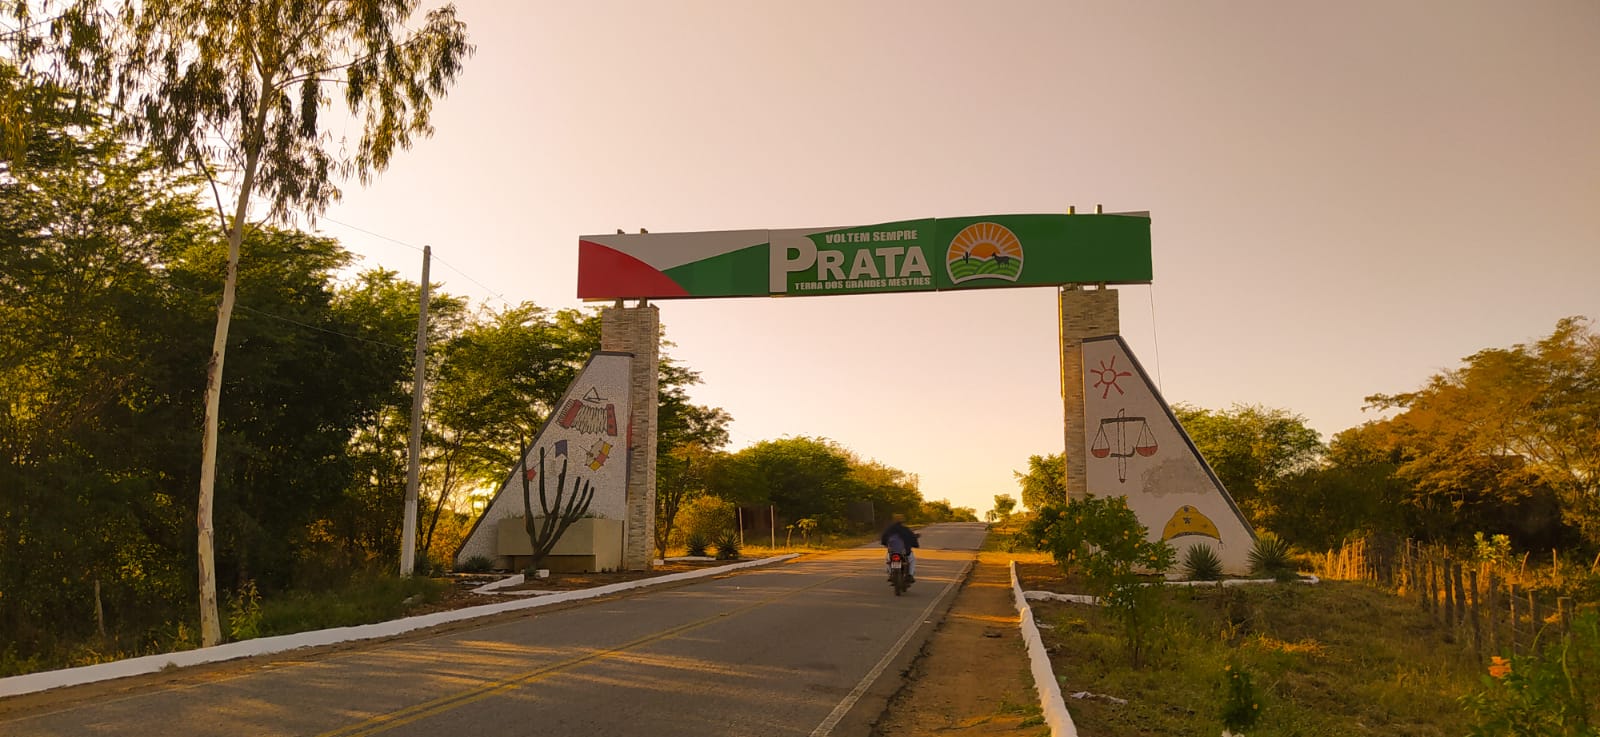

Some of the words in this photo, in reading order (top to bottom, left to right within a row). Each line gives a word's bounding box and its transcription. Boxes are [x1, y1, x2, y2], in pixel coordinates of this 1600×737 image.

[825, 232, 870, 244] VOLTEM
[873, 230, 918, 242] SEMPRE
[769, 234, 932, 293] PRATA
[794, 281, 823, 290] TERRA
[825, 280, 843, 289] DOS
[845, 279, 887, 289] GRANDES
[888, 277, 931, 287] MESTRES
